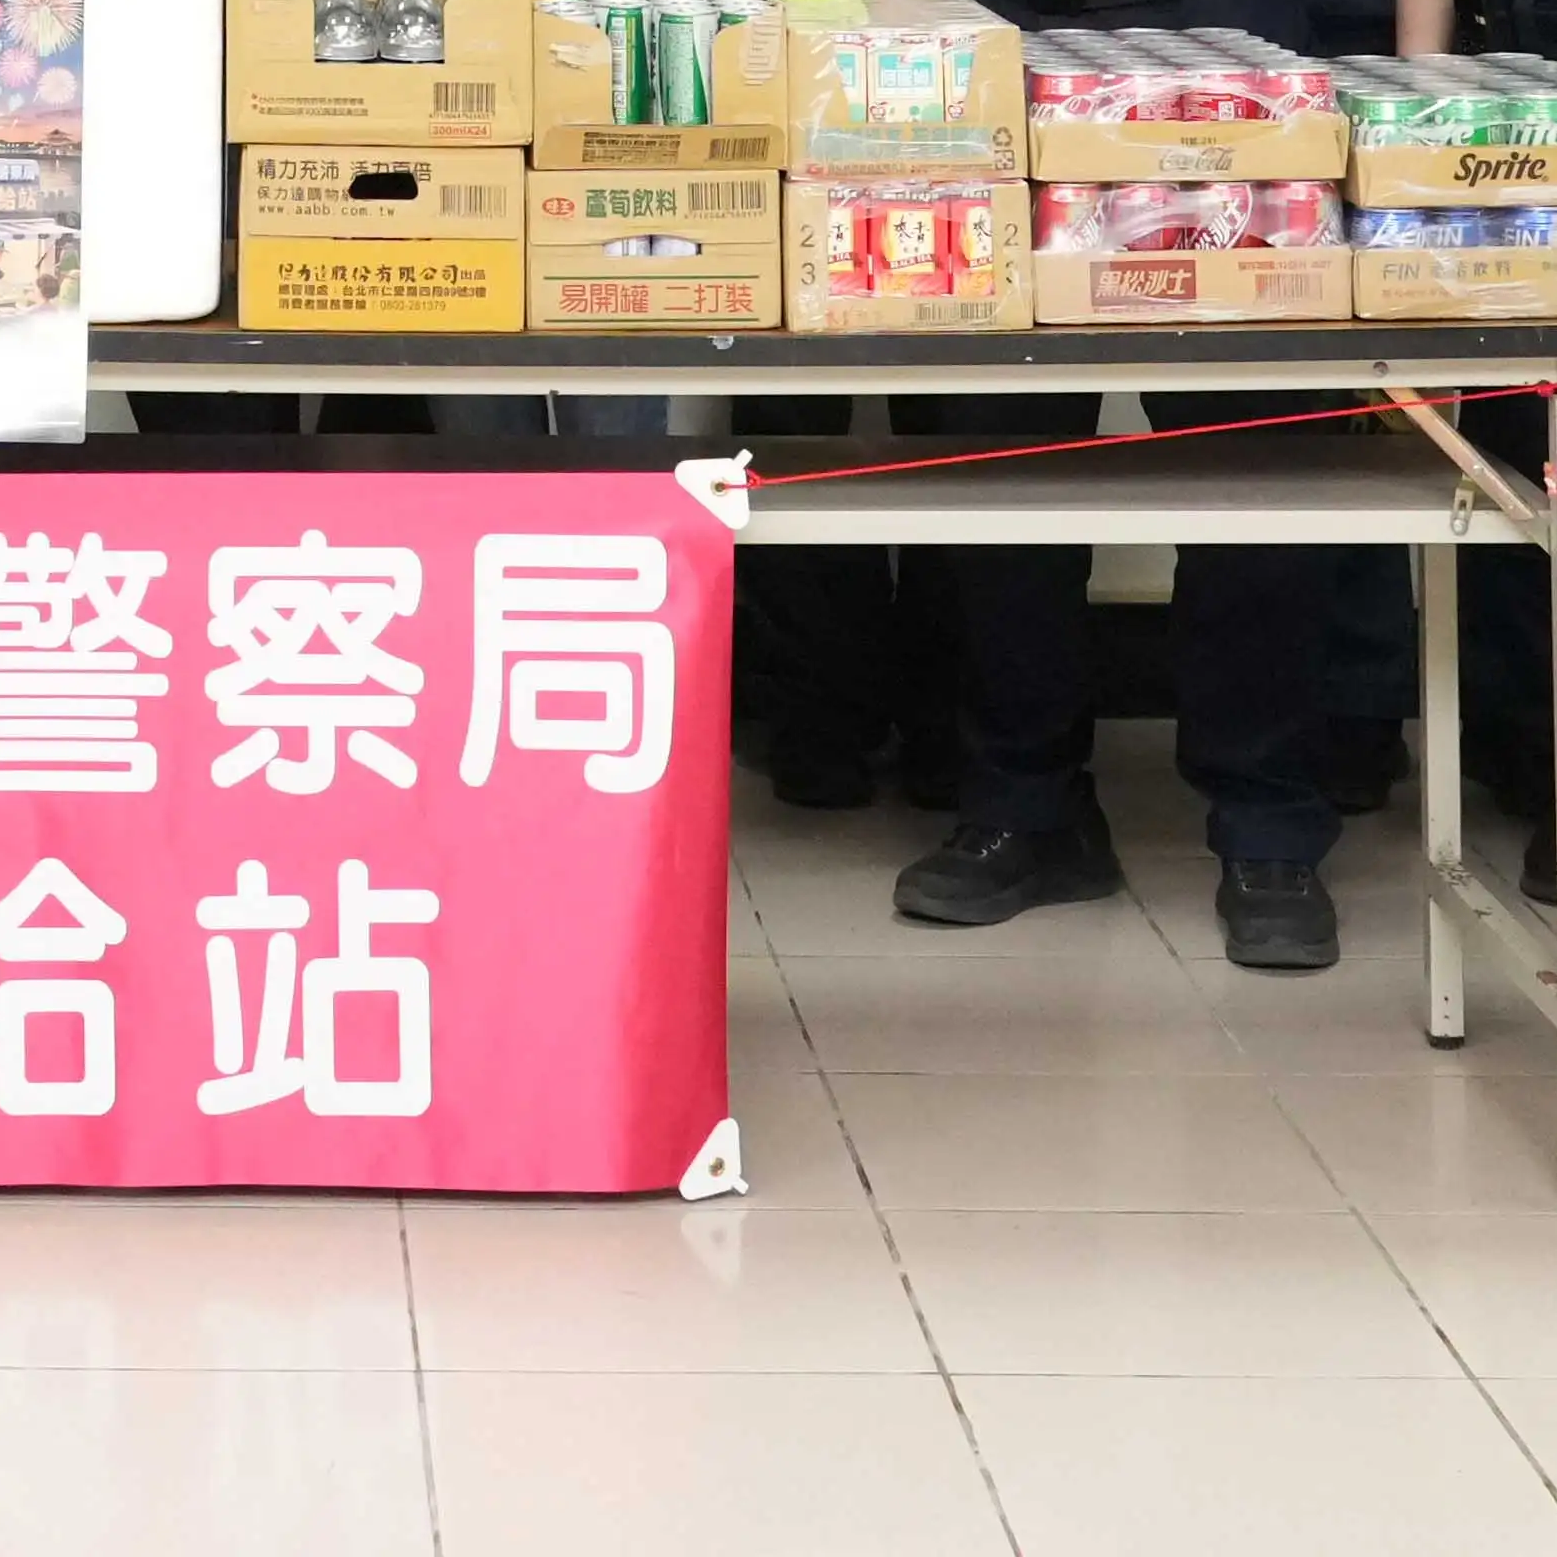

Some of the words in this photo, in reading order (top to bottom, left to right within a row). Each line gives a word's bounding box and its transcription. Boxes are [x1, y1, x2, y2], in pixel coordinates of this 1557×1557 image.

[257, 158, 340, 181] 精力充沛
[1454, 152, 1546, 187] Sprite
[258, 204, 395, 216] www.aabb.com.tw
[585, 188, 678, 218] 蘆筍飲料
[800, 224, 816, 248] 2
[1004, 223, 1019, 246] 2
[801, 262, 816, 285] 3
[1096, 269, 1192, 296] 黑松沙士
[560, 283, 649, 313] 易開罐
[663, 283, 753, 313] 二打裝
